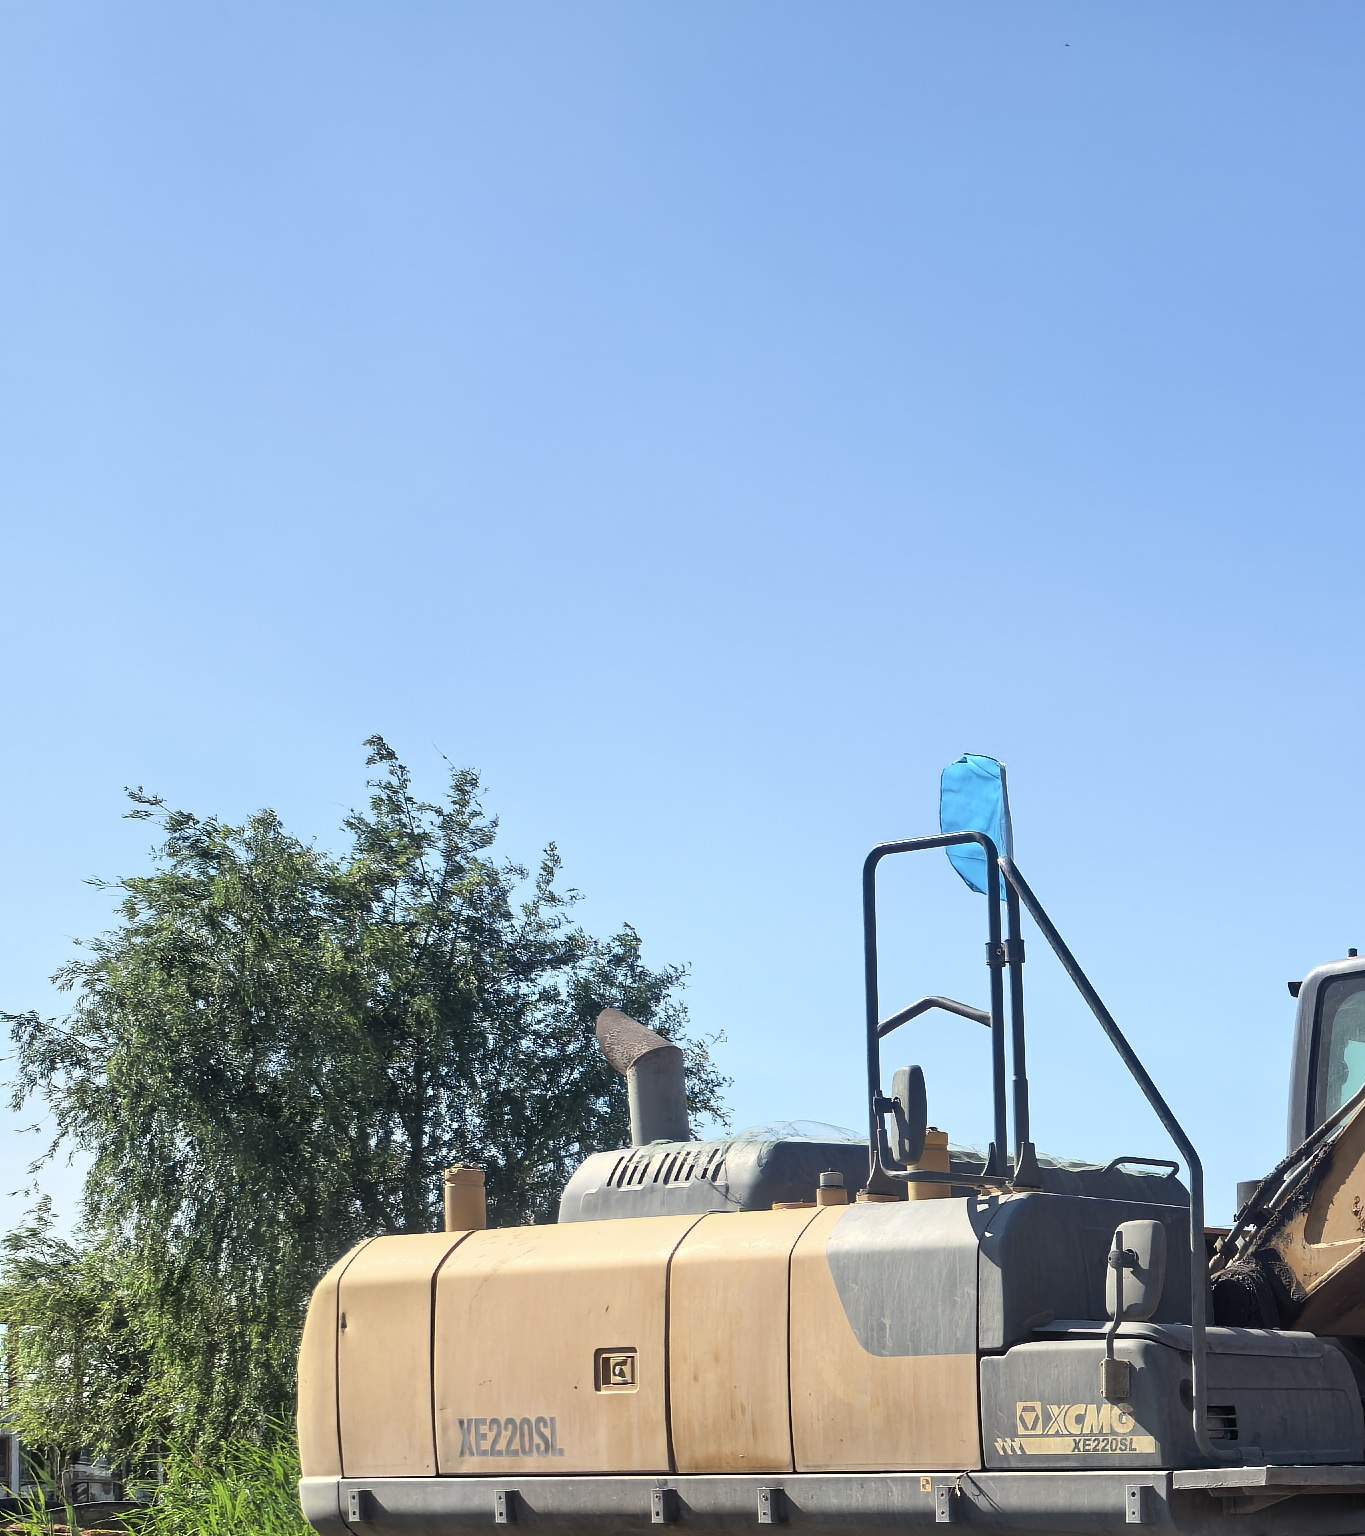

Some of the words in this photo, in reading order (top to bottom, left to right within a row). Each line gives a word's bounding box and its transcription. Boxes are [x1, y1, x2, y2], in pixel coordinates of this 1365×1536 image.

[1043, 1402, 1136, 1435] XCMG
[457, 1416, 565, 1457] XE220SL
[1072, 1438, 1137, 1453] XE220SL
